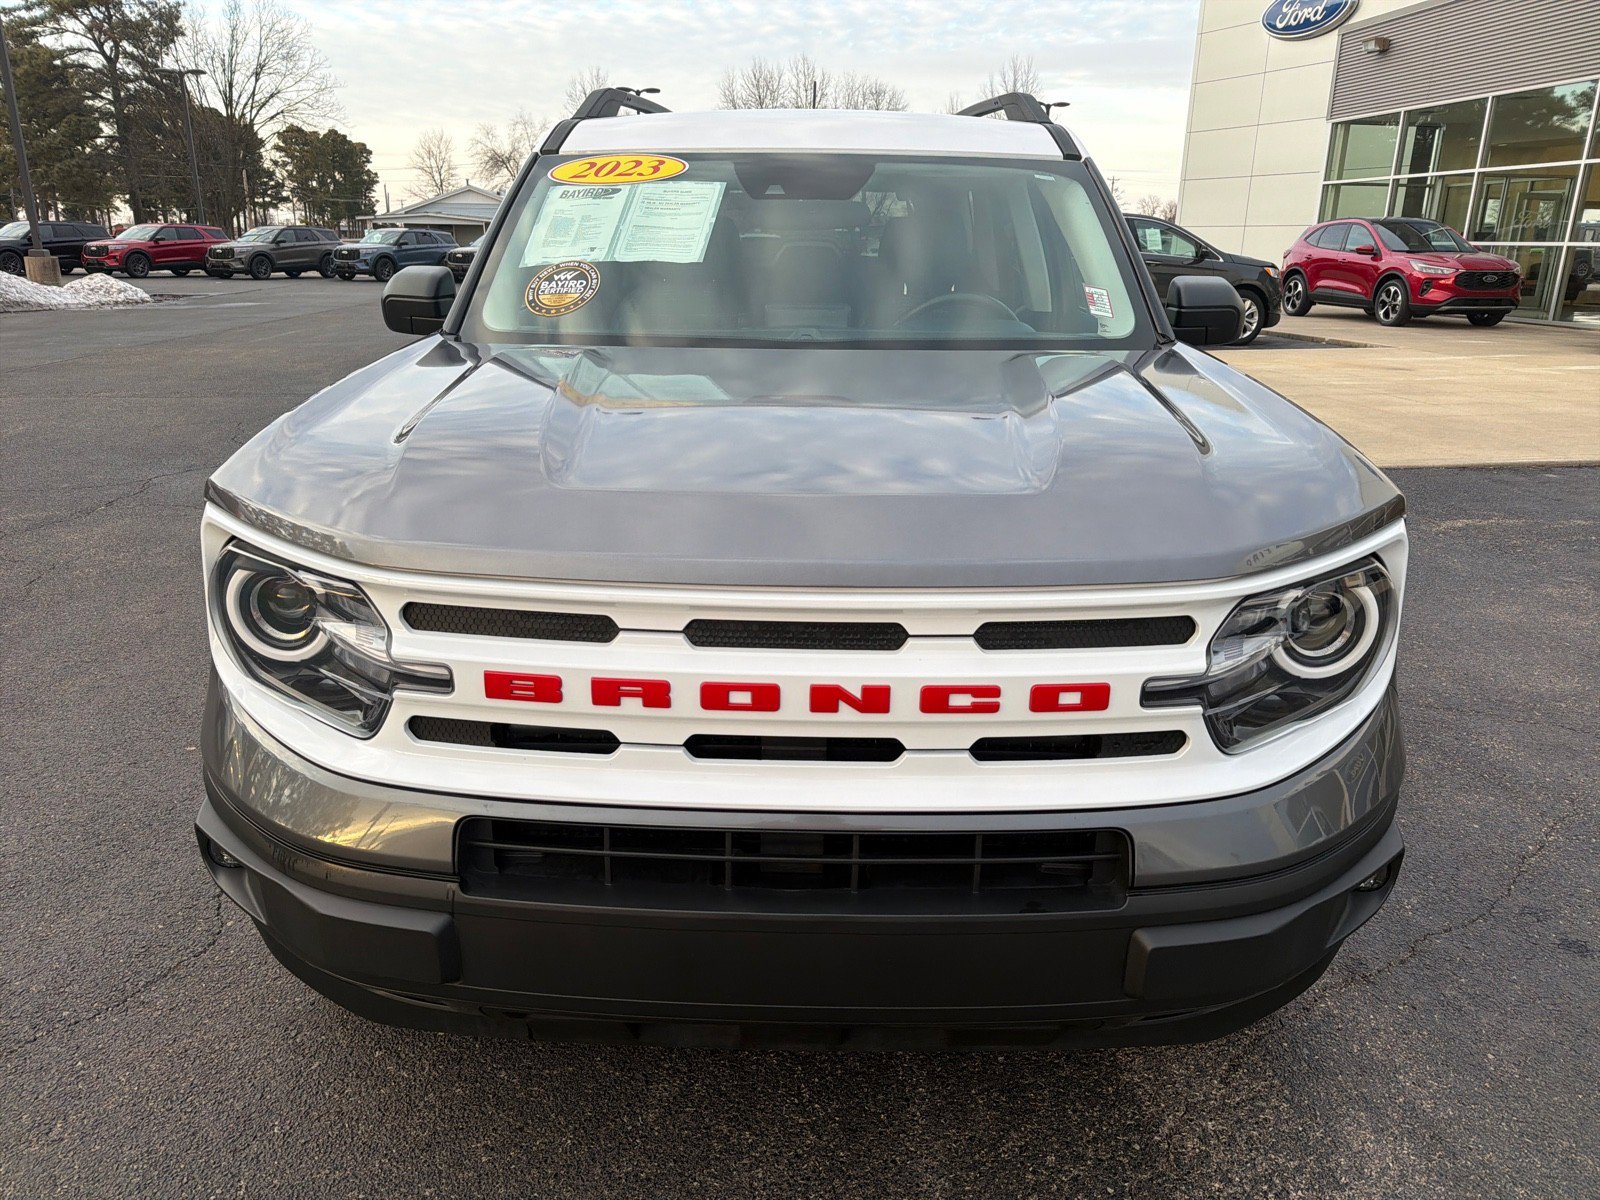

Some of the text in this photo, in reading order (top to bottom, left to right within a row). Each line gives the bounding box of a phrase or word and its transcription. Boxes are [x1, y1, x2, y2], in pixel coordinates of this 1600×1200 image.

[1275, 0, 1327, 29] Ford
[568, 159, 666, 179] 2023
[559, 187, 605, 200] BAYIRD
[580, 261, 592, 271] YOU
[540, 279, 587, 289] BAYIRD
[538, 287, 584, 295] CERTIFIED
[483, 669, 1112, 714] BRONCO
